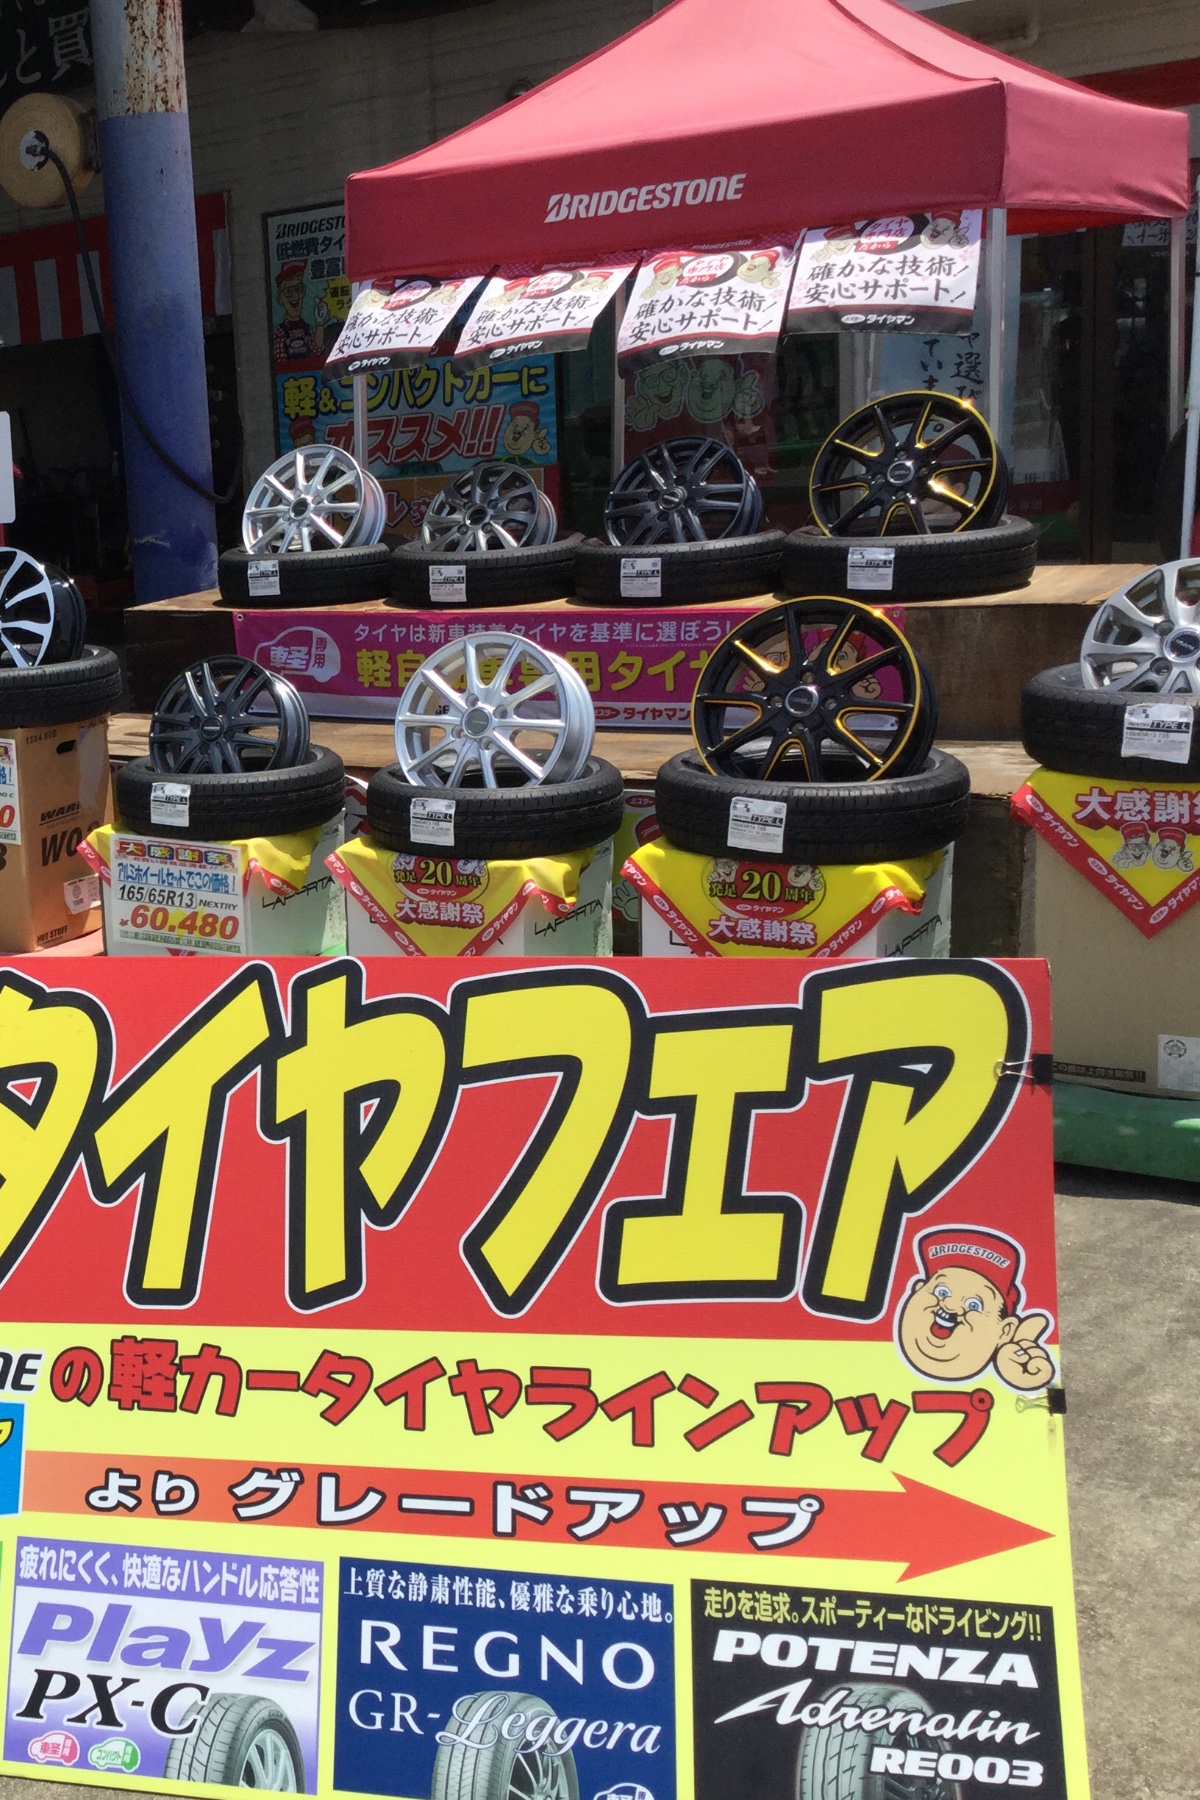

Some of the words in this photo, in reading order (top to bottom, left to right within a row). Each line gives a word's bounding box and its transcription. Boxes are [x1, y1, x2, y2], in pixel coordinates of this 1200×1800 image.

[544, 173, 747, 223] BRIDGESTONE
[275, 215, 345, 239] BRIDGEST
[276, 234, 345, 261] 低燃費タイ
[310, 256, 345, 280] 豊富
[806, 254, 969, 281] 確かな技術!
[634, 285, 779, 320] 確かな技術!
[804, 276, 967, 305] 安心サポート!
[476, 294, 600, 324] 確かな技術!
[629, 308, 773, 344] 安心サポート!
[466, 313, 589, 348] 安心サポート!
[622, 707, 691, 721] タイヤマン
[1041, 811, 1080, 848] タイヤマン
[119, 884, 195, 908] 165/65R13
[199, 899, 238, 911] NEXTRY
[753, 904, 785, 914] タイヤマン
[1105, 873, 1145, 911] タイヤマン
[395, 899, 485, 926] 大感謝祭
[666, 909, 698, 943] タイヤマン
[708, 915, 817, 945] 大感謝祭
[829, 919, 863, 951] タイヤマン
[928, 1242, 1010, 1271] BRIDGESTONE
[51, 1336, 996, 1468] の軽カータイヤラインアップ
[87, 1469, 197, 1515] より
[231, 1467, 825, 1548] グレードアップ
[19, 1542, 320, 1605] 疲れにくく、快適なハンドル応答性
[342, 1566, 674, 1625] 上質な静粛性能、優雅な乗り心地。
[704, 1587, 1043, 1643] 走りを追求。スポーティーなドライビング!!
[16, 1601, 318, 1683] Playz
[360, 1619, 656, 1690] REGNO
[712, 1629, 1040, 1690] POTENZA
[15, 1667, 210, 1735] PX-C
[715, 1678, 1041, 1747] Adrenalin
[348, 1688, 660, 1756] GR-Leggera
[871, 1746, 1043, 1786] RE003
